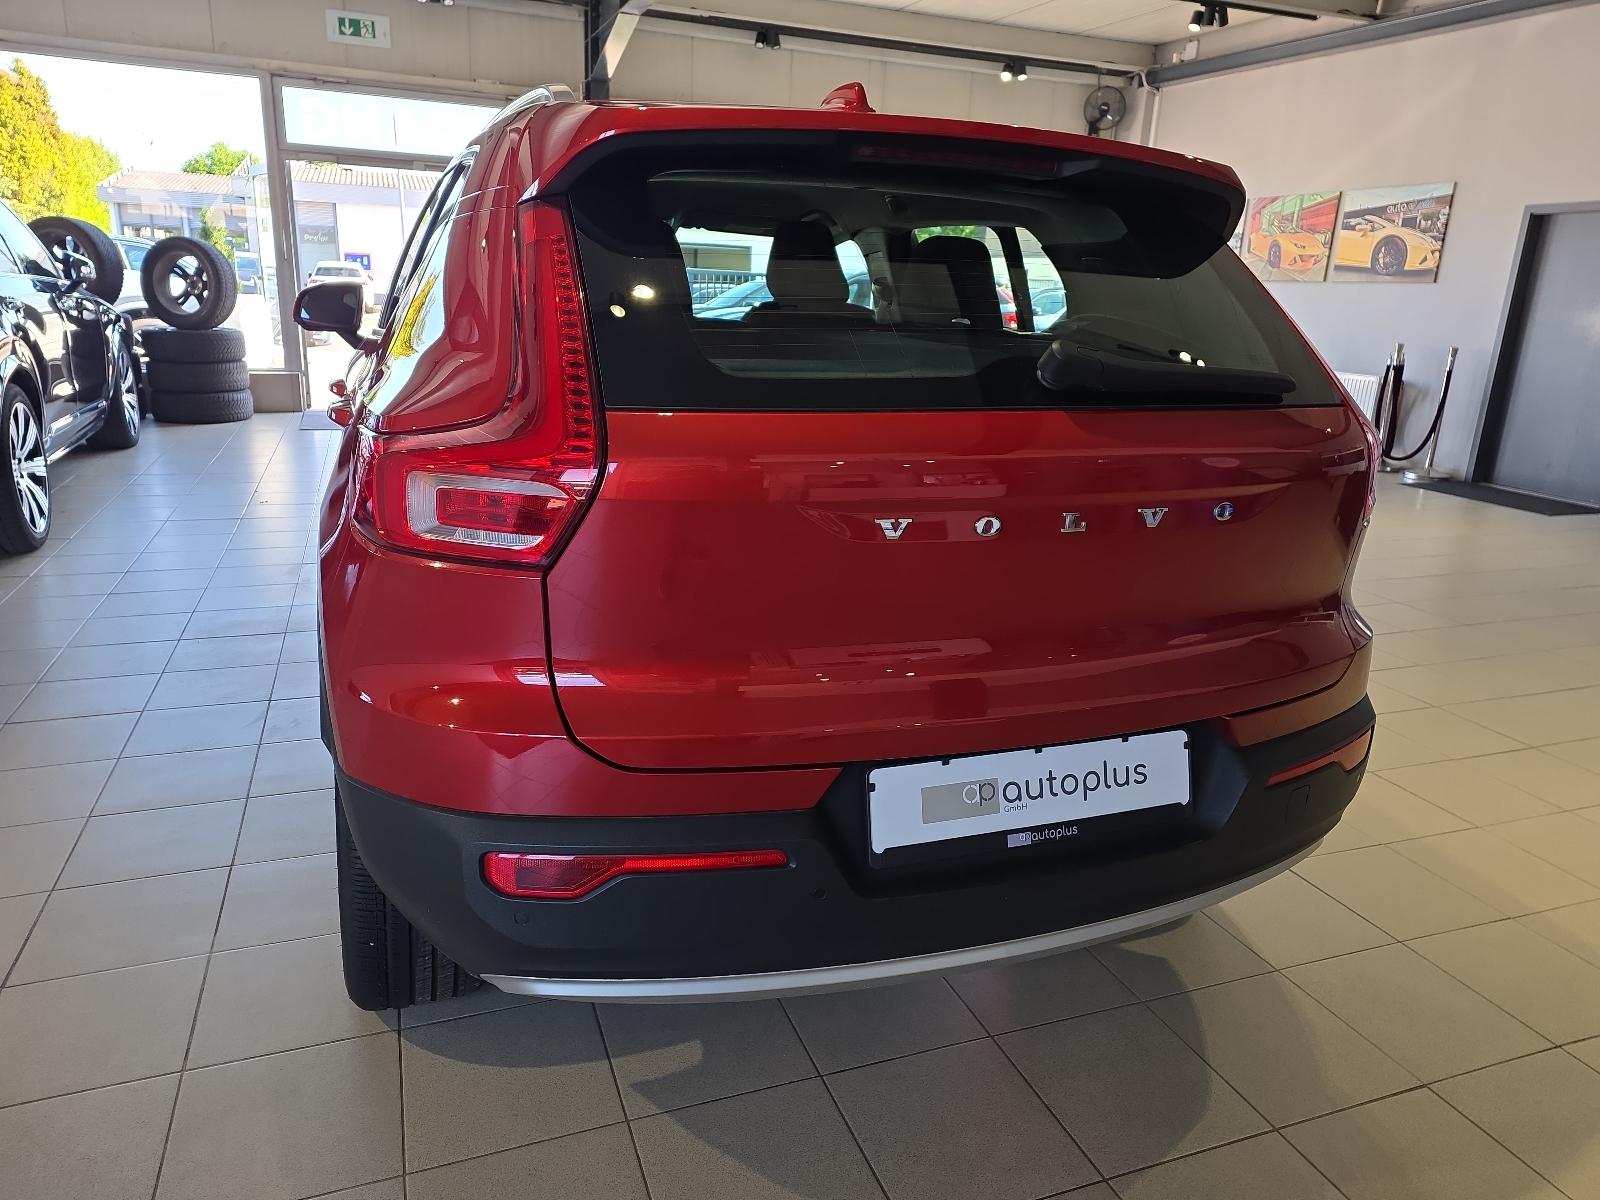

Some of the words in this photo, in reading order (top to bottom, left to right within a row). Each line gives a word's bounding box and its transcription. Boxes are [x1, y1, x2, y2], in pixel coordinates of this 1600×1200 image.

[874, 501, 1234, 540] VOLVO
[1002, 759, 1148, 804] autoplus
[1003, 802, 1028, 813] GmbH
[1031, 825, 1078, 841] autoplus
